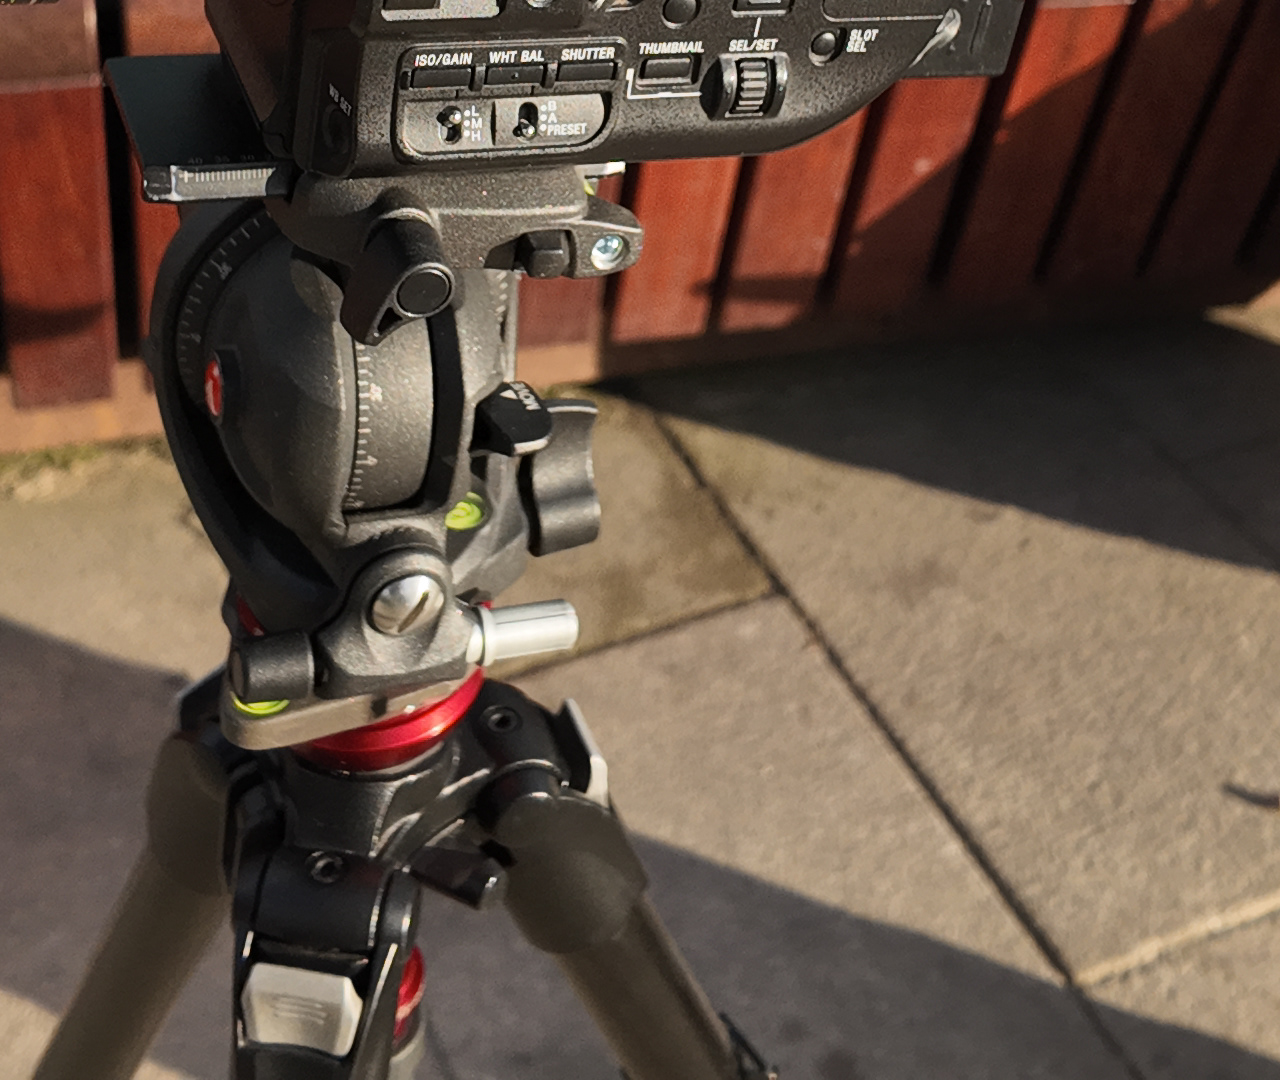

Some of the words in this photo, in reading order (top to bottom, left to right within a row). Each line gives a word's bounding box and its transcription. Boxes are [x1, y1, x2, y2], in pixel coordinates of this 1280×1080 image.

[850, 29, 879, 41] SLOT
[639, 41, 705, 56] THUMBNAIL
[728, 38, 778, 52] SEL/SET
[846, 40, 867, 52] SEL
[414, 52, 473, 67] ISO/GAIN
[489, 50, 517, 64] WHT
[520, 49, 544, 62] BAL
[561, 47, 615, 62] SHUTTER
[471, 105, 479, 117] L
[547, 100, 557, 111] B
[471, 118, 482, 129] M
[547, 112, 557, 123] A
[547, 123, 587, 136] PRESET
[471, 131, 482, 142] H
